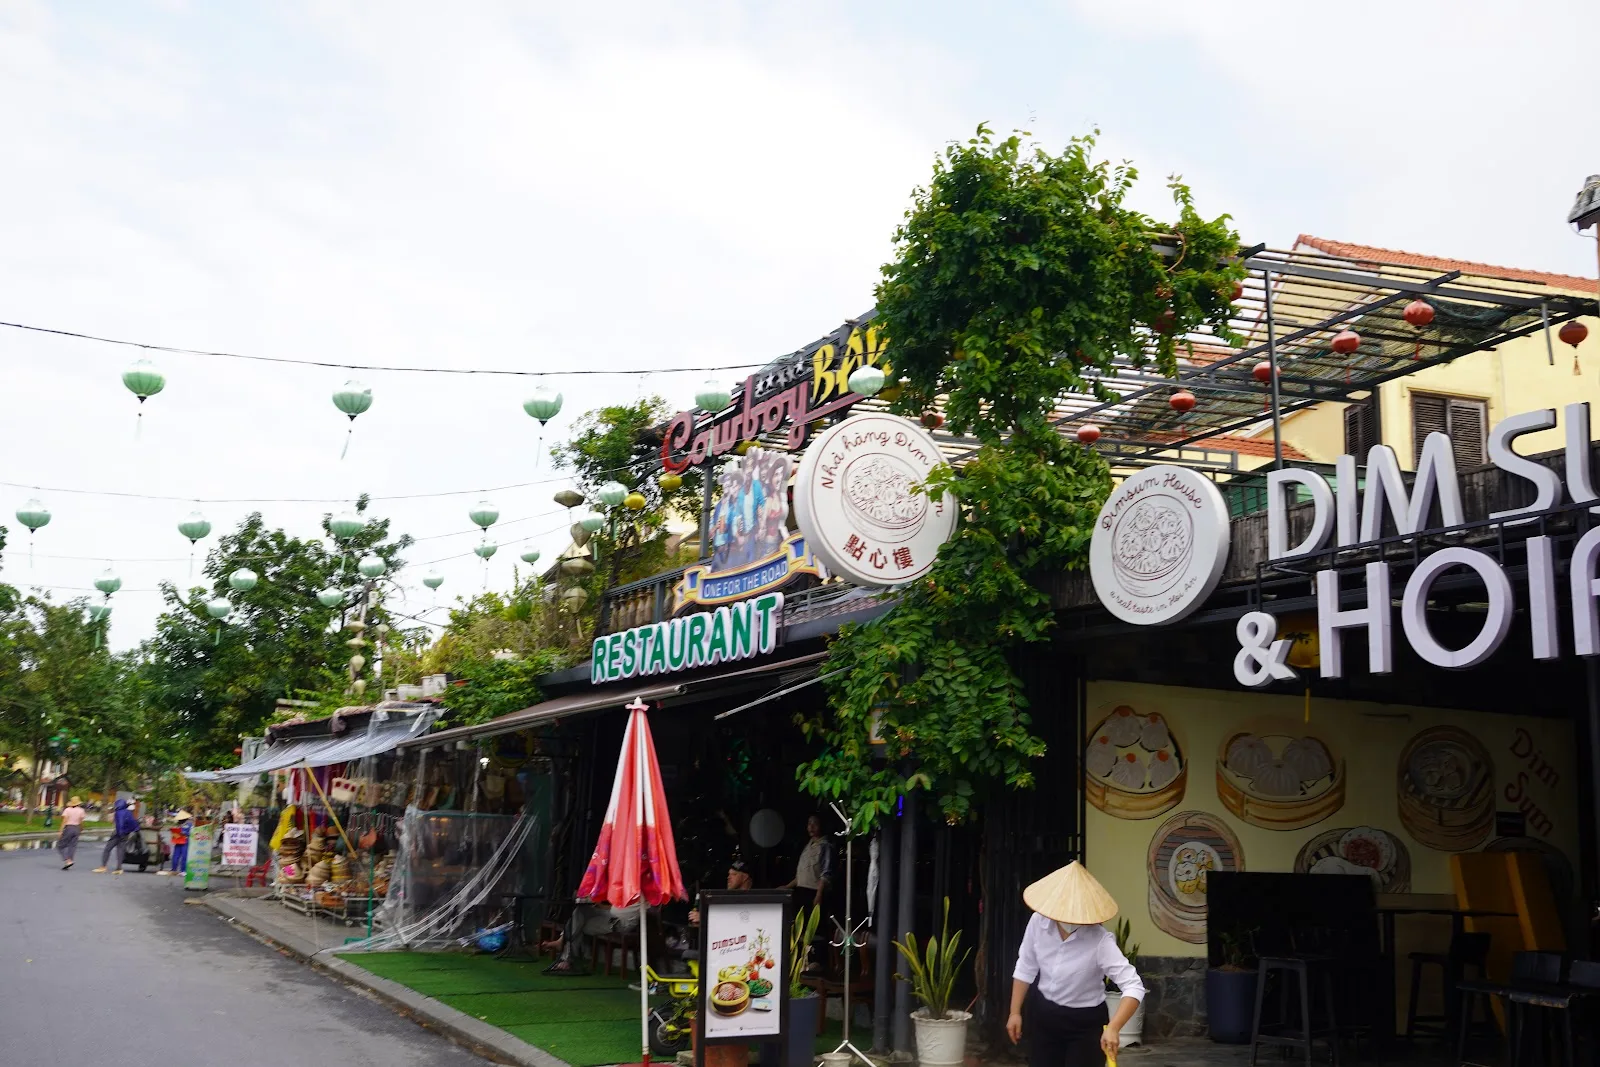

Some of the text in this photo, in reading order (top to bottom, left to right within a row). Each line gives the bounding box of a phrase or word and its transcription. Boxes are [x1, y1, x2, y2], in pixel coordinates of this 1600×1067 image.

[660, 375, 812, 475] Cowboy
[1162, 473, 1202, 509] House
[703, 560, 789, 598] ONE FOR THE ROAD
[843, 533, 915, 571] 點心樓
[591, 593, 782, 685] RESTAURANT
[1234, 612, 1298, 687] &
[1509, 727, 1559, 788] Dim
[1504, 771, 1554, 836] Sum
[711, 934, 747, 951] DIMSUM
